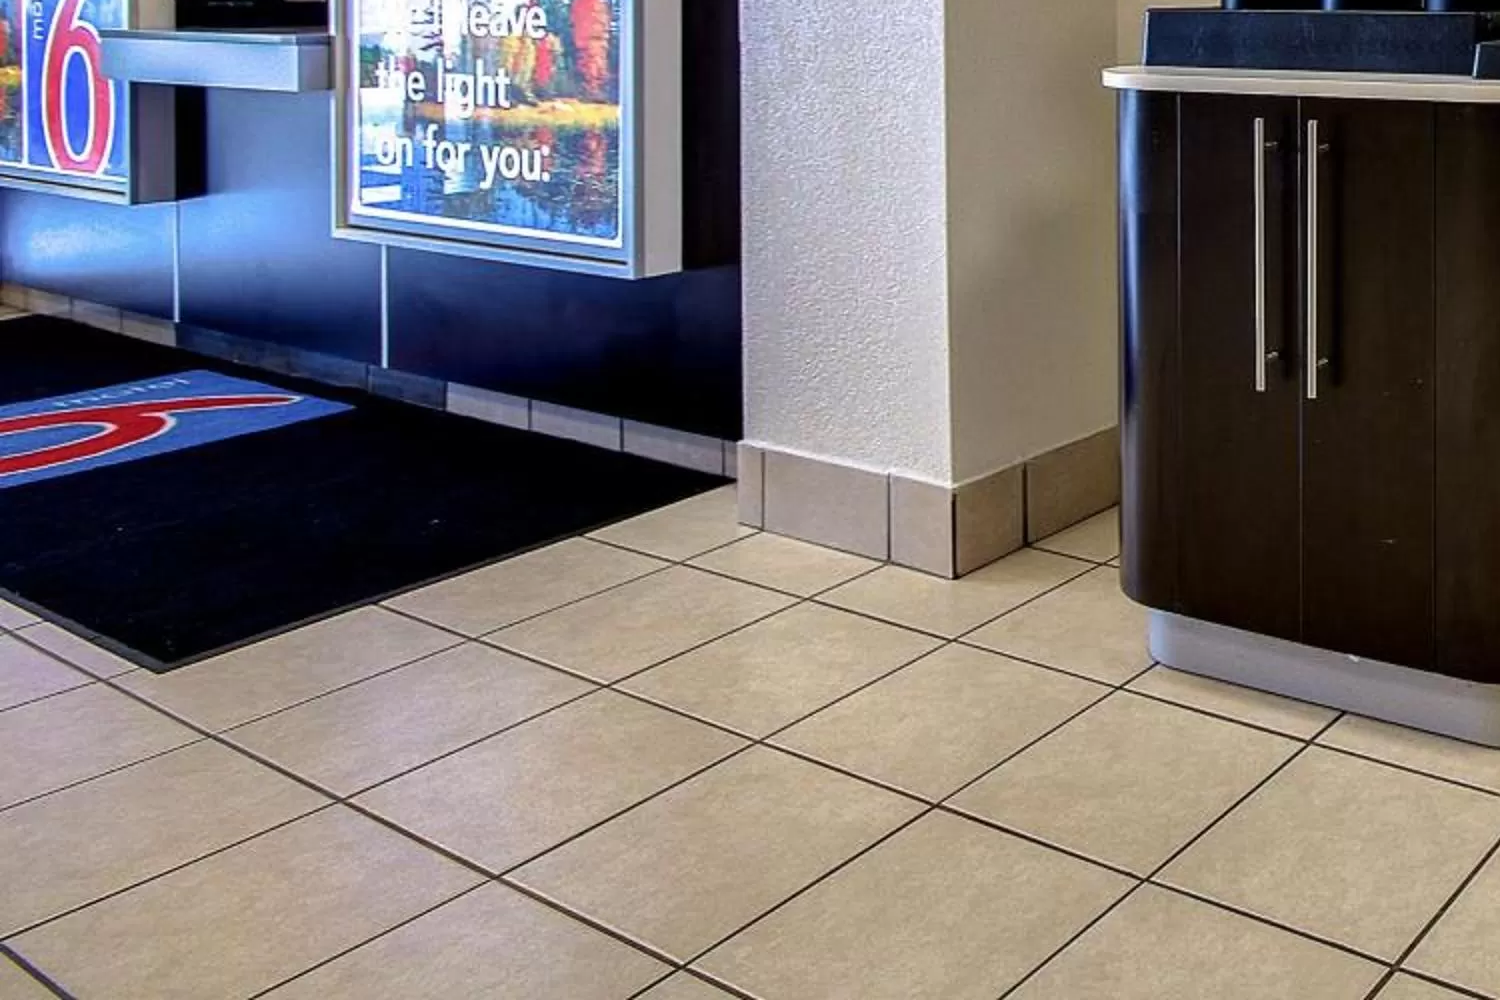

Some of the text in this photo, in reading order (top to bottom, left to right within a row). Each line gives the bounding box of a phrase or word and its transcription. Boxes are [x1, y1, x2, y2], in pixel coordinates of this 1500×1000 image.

[374, 54, 512, 120] the light
[375, 134, 414, 168] on
[422, 123, 472, 175] for
